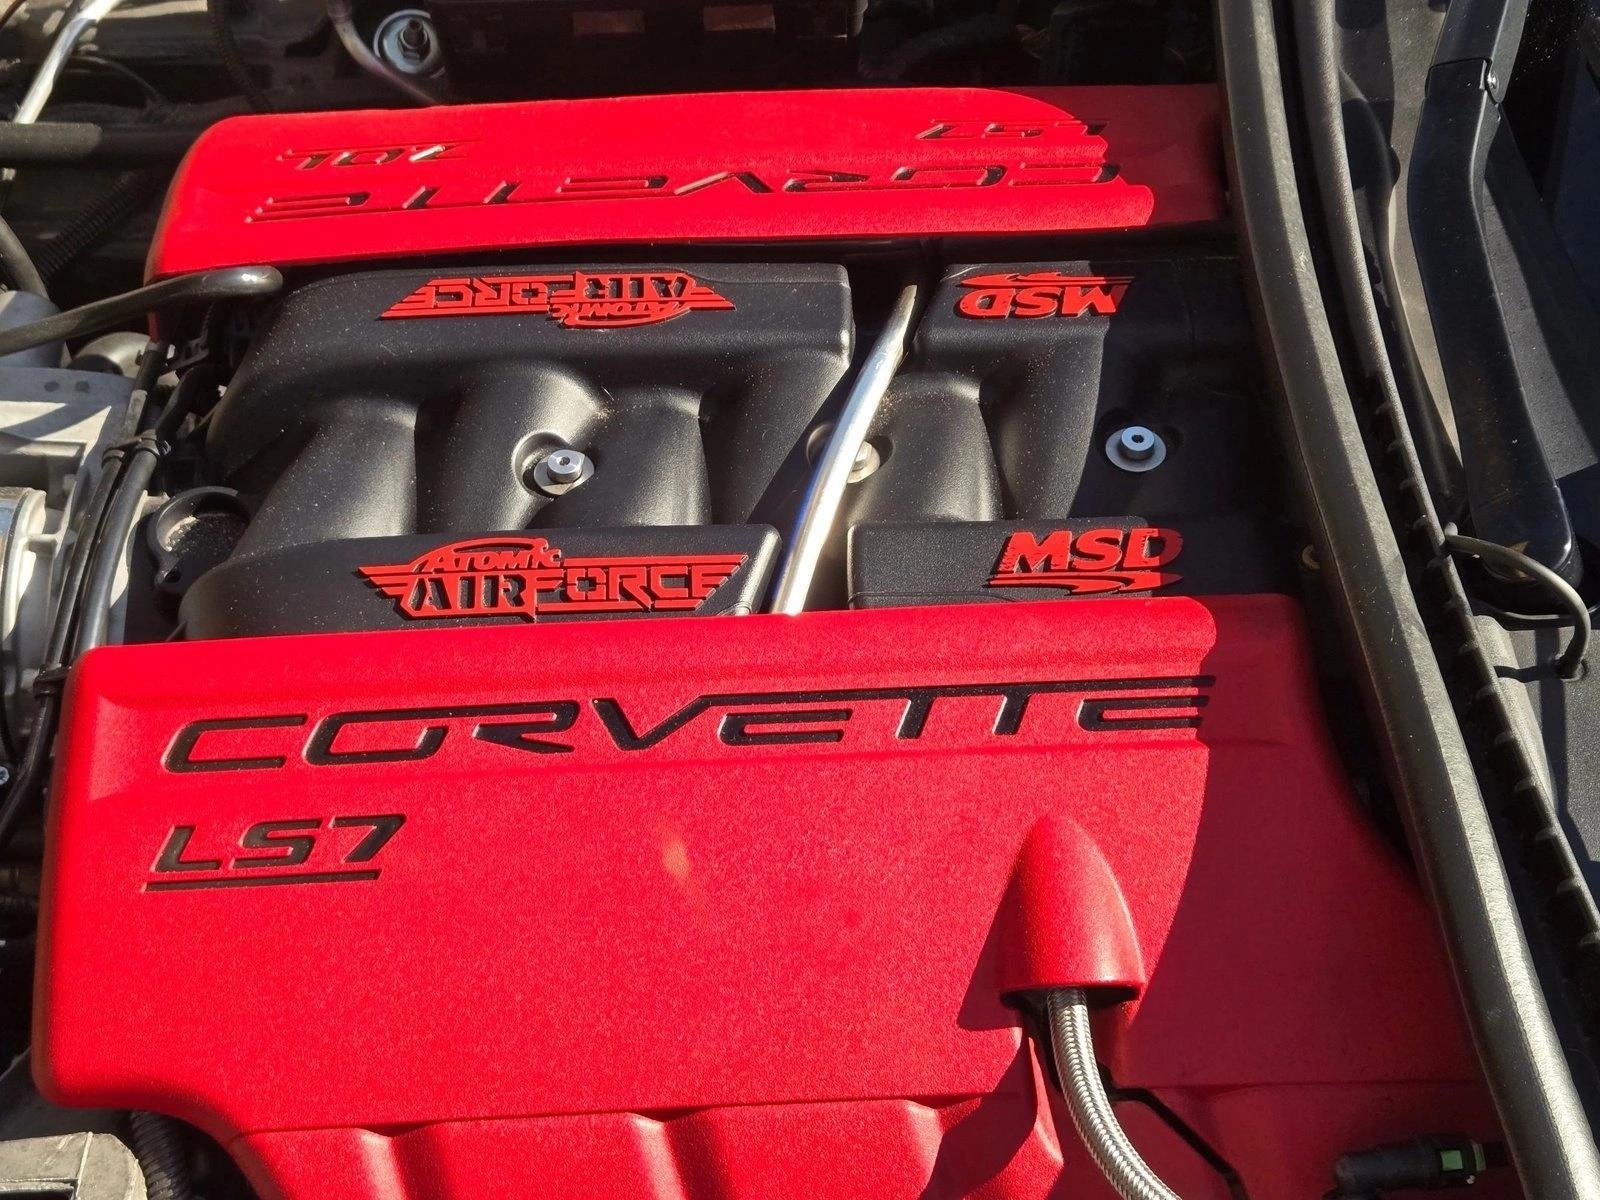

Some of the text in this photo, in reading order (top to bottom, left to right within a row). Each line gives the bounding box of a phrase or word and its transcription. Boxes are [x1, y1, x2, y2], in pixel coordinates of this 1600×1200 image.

[245, 160, 1121, 223] CORVETTE
[959, 285, 1129, 319] MSD
[996, 527, 1183, 574] MSD
[160, 675, 1216, 773] CORVETTE
[151, 813, 407, 873] LS7
